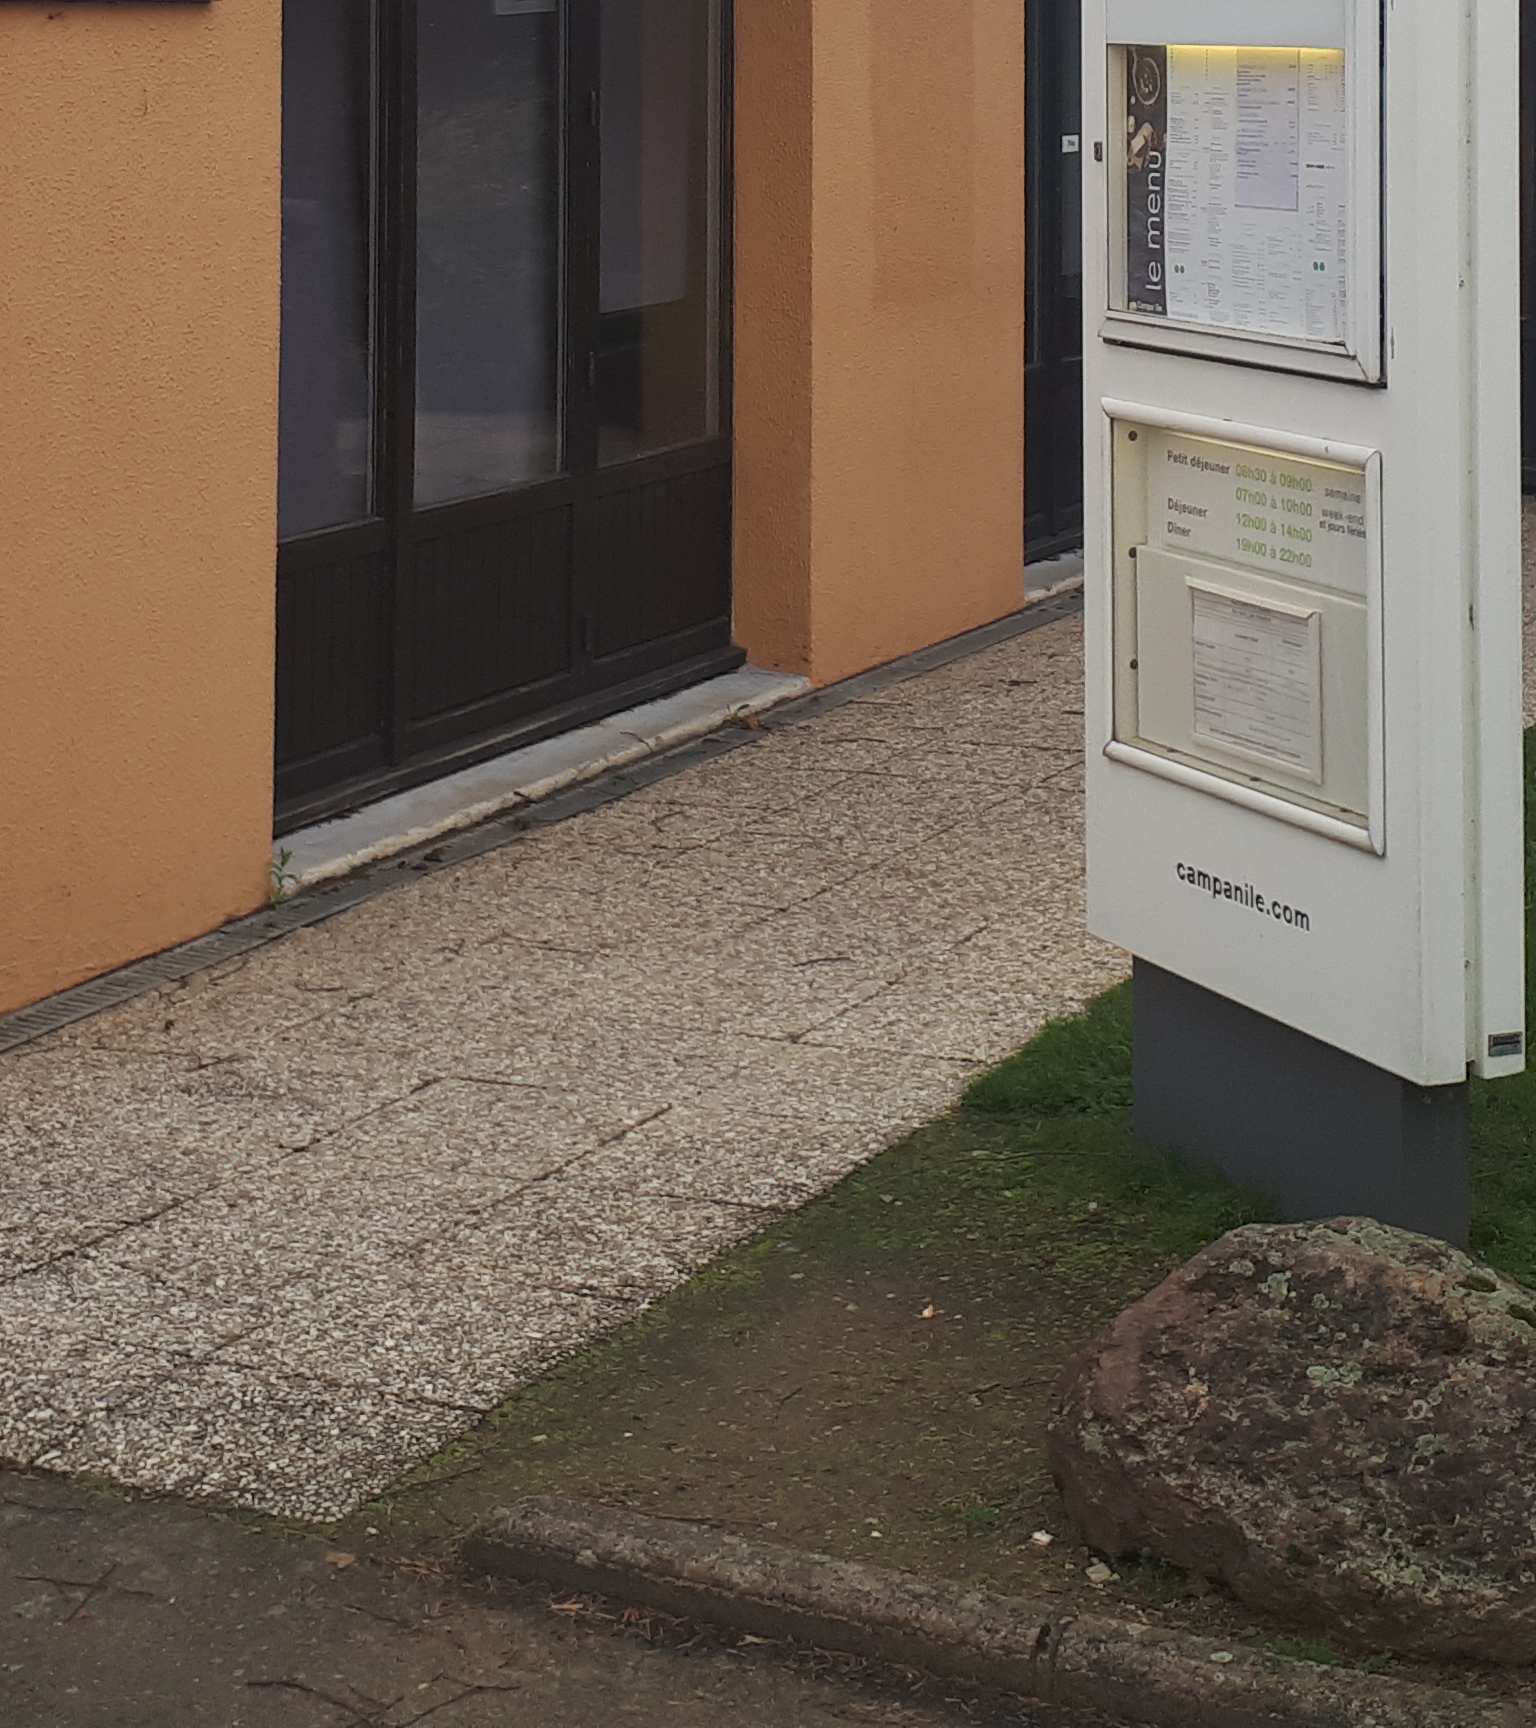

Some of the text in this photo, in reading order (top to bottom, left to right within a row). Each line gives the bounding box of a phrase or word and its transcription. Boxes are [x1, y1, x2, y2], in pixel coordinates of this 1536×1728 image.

[1145, 149, 1162, 291] le menu
[1167, 449, 1189, 466] Petit
[1190, 453, 1230, 475] déjeuner
[1167, 497, 1208, 518] Déjeuner
[1270, 519, 1277, 534] à
[1270, 494, 1277, 509] à
[1281, 498, 1312, 517] 10h00
[1280, 547, 1312, 568] 22h00
[1175, 860, 1311, 933] campanile.com
